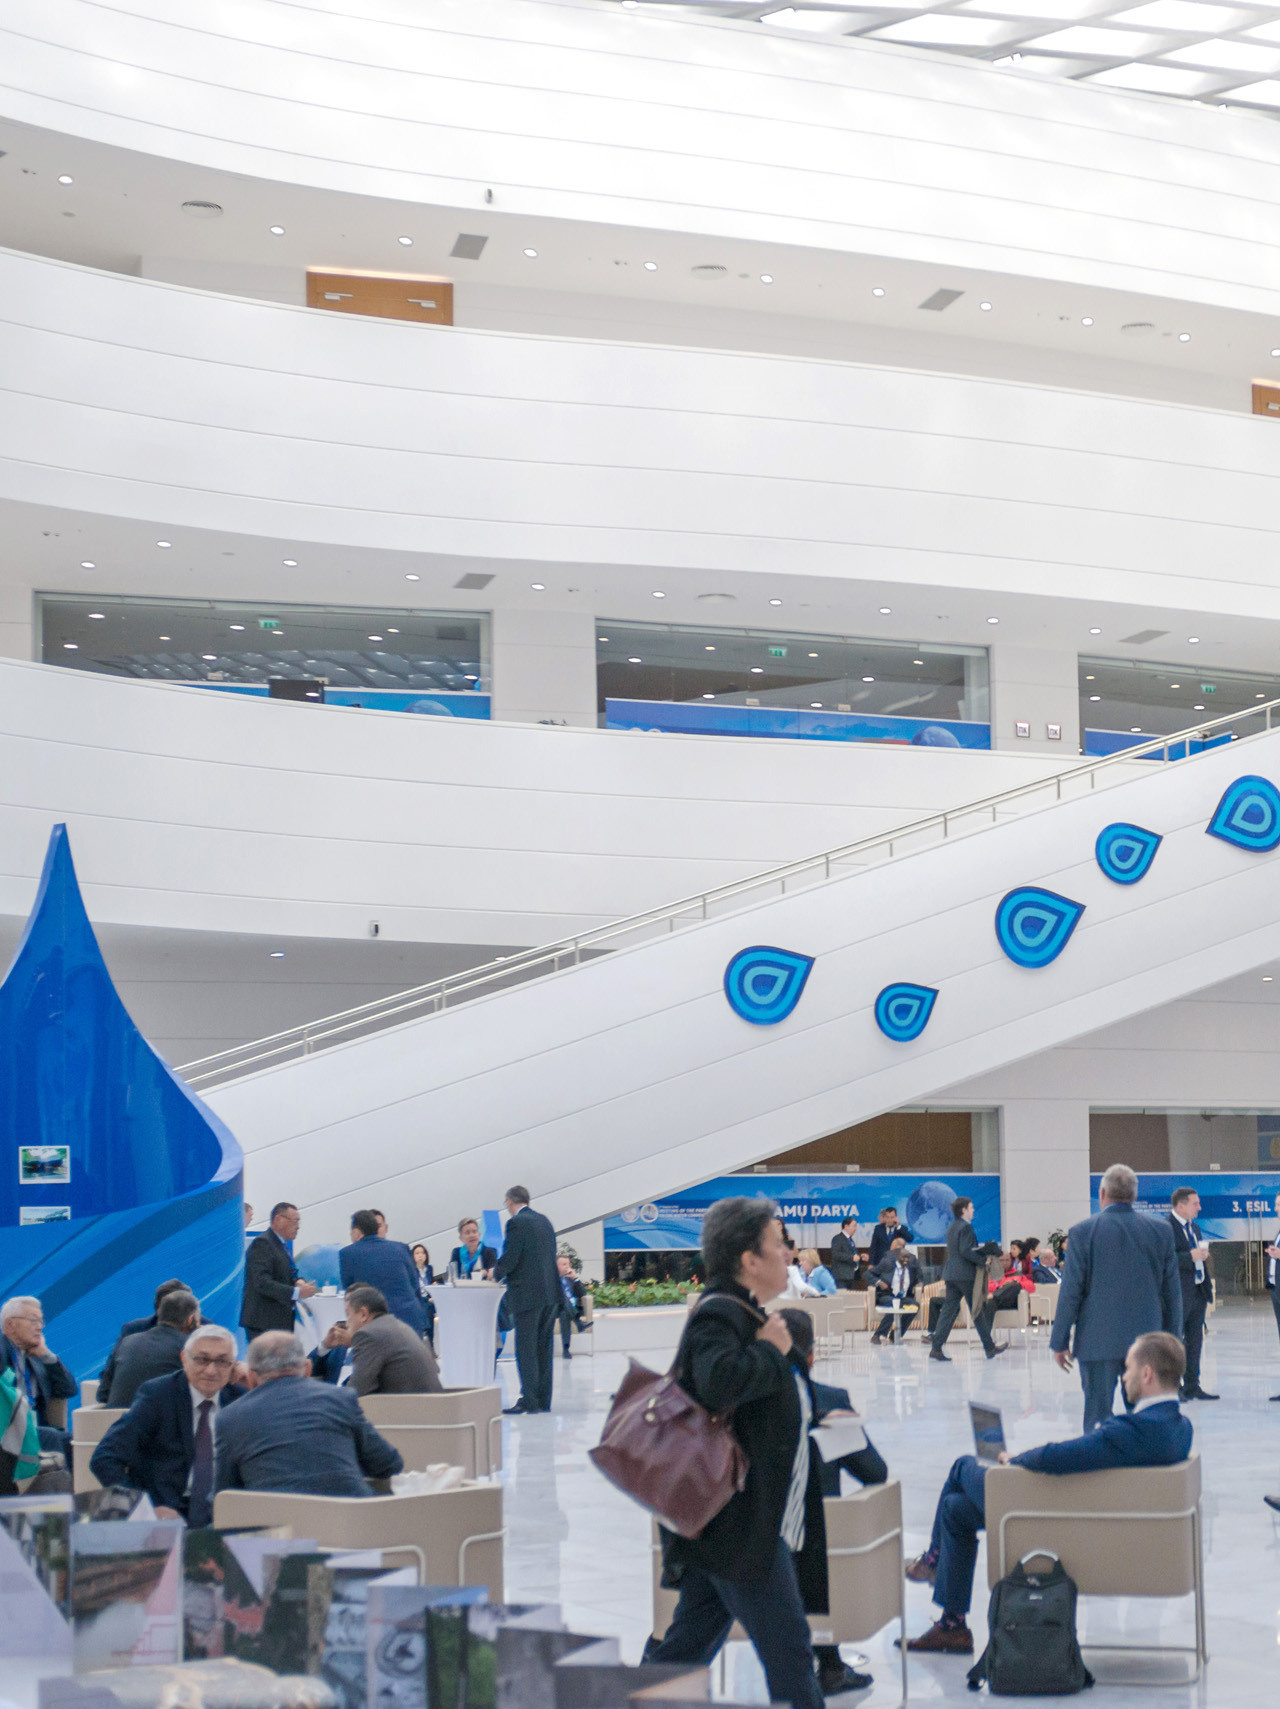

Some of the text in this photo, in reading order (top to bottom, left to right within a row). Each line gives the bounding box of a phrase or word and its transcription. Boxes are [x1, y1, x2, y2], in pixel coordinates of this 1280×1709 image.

[774, 1204, 860, 1217] AMU DARYA
[1232, 1201, 1271, 1212] 3. ESIL
